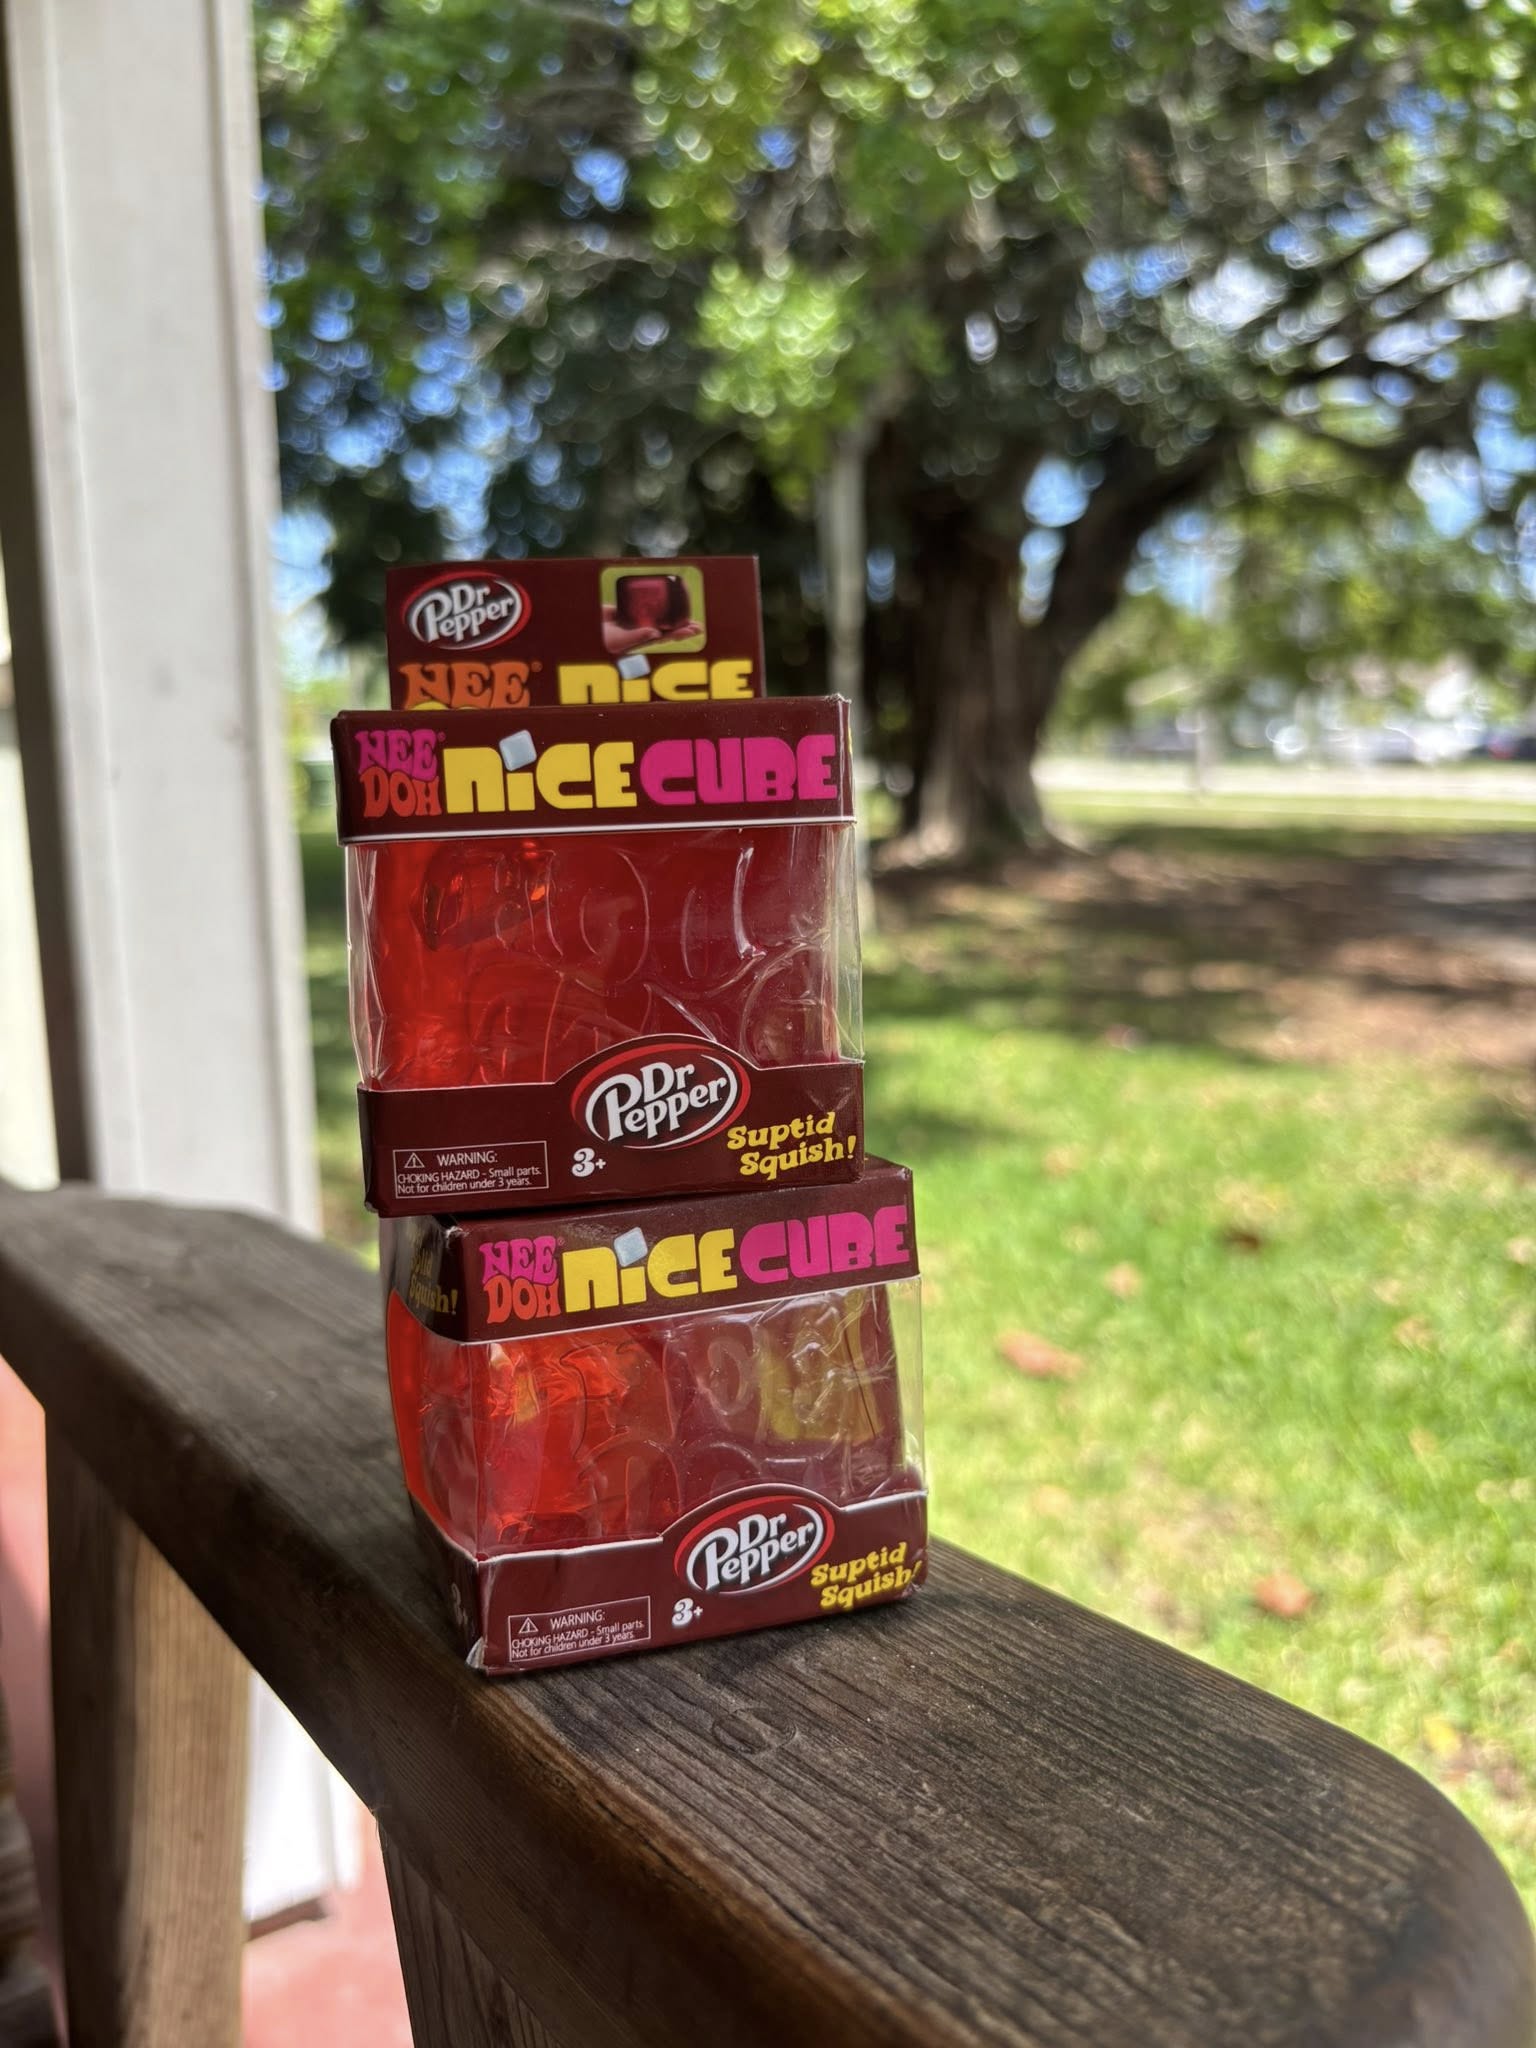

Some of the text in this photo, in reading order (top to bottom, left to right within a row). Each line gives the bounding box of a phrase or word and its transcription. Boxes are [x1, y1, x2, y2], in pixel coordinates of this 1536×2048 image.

[422, 591, 515, 642] Pepper
[449, 582, 491, 618] Dr
[399, 660, 531, 709] NEE
[354, 728, 438, 781] NEE
[638, 734, 839, 807] CUBE
[359, 765, 442, 818] DOH
[639, 1061, 696, 1103] Dr
[602, 1072, 728, 1142] Pepper
[726, 1110, 836, 1150] Suptid
[397, 1171, 440, 1184] CHOKING
[441, 1168, 480, 1182] HAZARD
[488, 1166, 515, 1179] Small
[516, 1166, 543, 1179] parts.
[436, 1150, 499, 1167] WARNING:
[571, 1147, 607, 1178] 3+
[739, 1134, 857, 1181] Squish!
[397, 1176, 532, 1195] Not for children under 3 years.
[478, 1235, 558, 1286] NEE
[739, 1204, 912, 1285] CUBE
[483, 1274, 562, 1325] DOH
[737, 1513, 787, 1553] Dr
[703, 1522, 815, 1591] Pepper
[549, 1609, 606, 1630] WARNING:
[671, 1597, 704, 1627] 3+
[511, 1634, 551, 1650] CHOKING
[552, 1628, 589, 1643] HAZARD
[596, 1622, 620, 1636] Small
[621, 1620, 645, 1633] parts.
[511, 1648, 528, 1659] Not
[530, 1646, 542, 1657] for
[543, 1640, 577, 1654] children
[578, 1636, 603, 1649] under
[604, 1634, 611, 1644] 3
